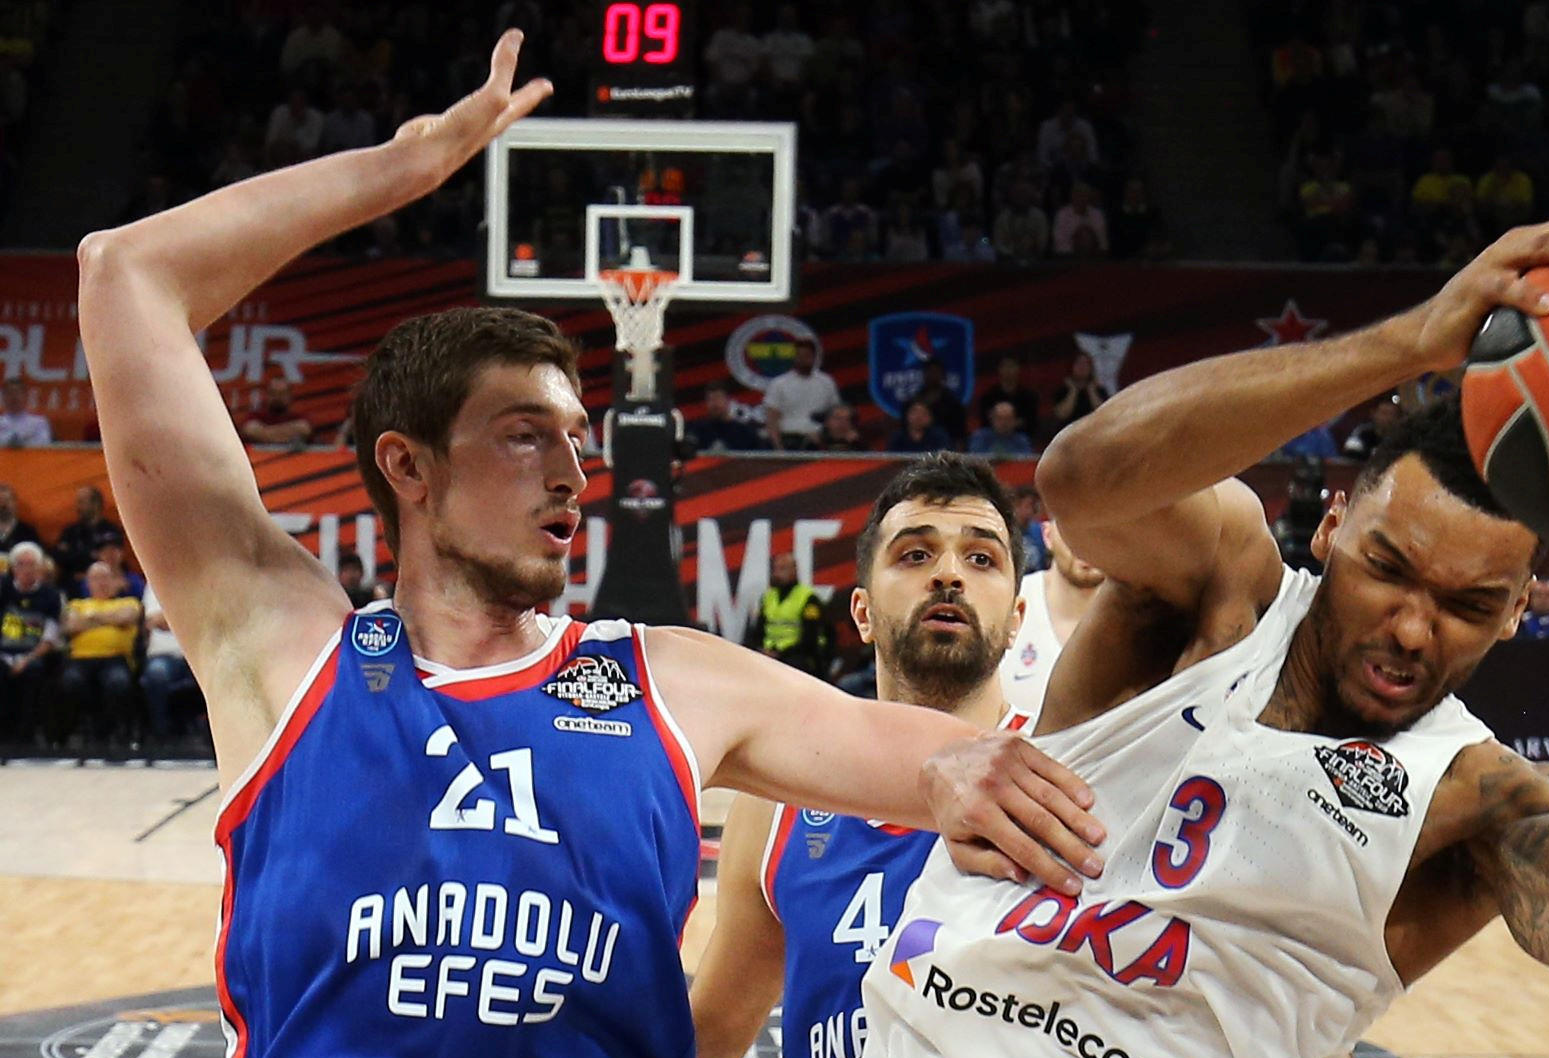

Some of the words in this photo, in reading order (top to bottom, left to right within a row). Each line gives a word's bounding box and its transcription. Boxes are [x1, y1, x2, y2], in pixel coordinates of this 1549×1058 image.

[603, 3, 681, 64] 09
[546, 681, 637, 698] FINALFOUR
[557, 718, 629, 733] oneteam
[426, 725, 559, 844] 21
[1319, 749, 1404, 814] FINALFOUR
[1151, 776, 1227, 890] 3
[1307, 789, 1368, 847] oneteam
[346, 882, 620, 983] ANADOLU
[388, 954, 573, 1026] EFES
